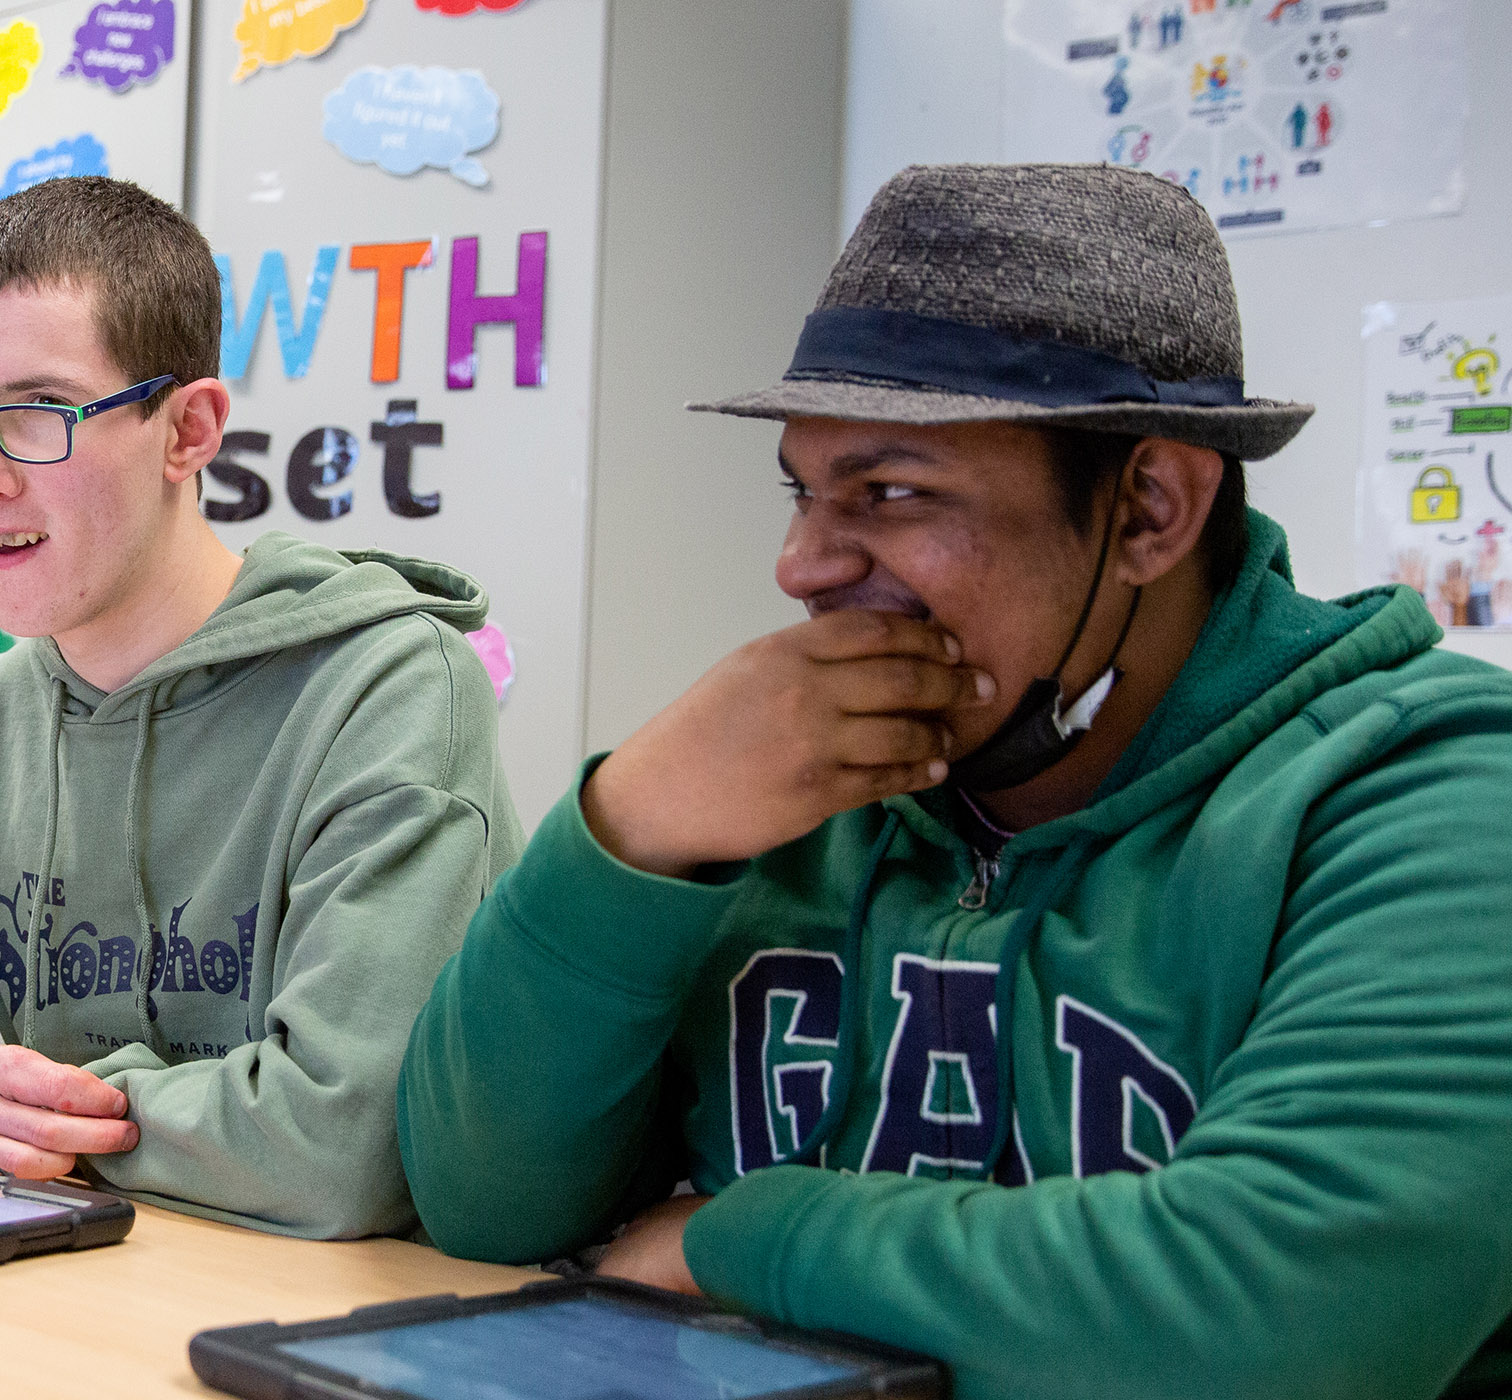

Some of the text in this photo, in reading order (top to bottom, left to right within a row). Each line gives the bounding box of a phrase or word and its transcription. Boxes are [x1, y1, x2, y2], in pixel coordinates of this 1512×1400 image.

[85, 1032, 228, 1057] TRA MARK
[729, 947, 1198, 1187] GAP
